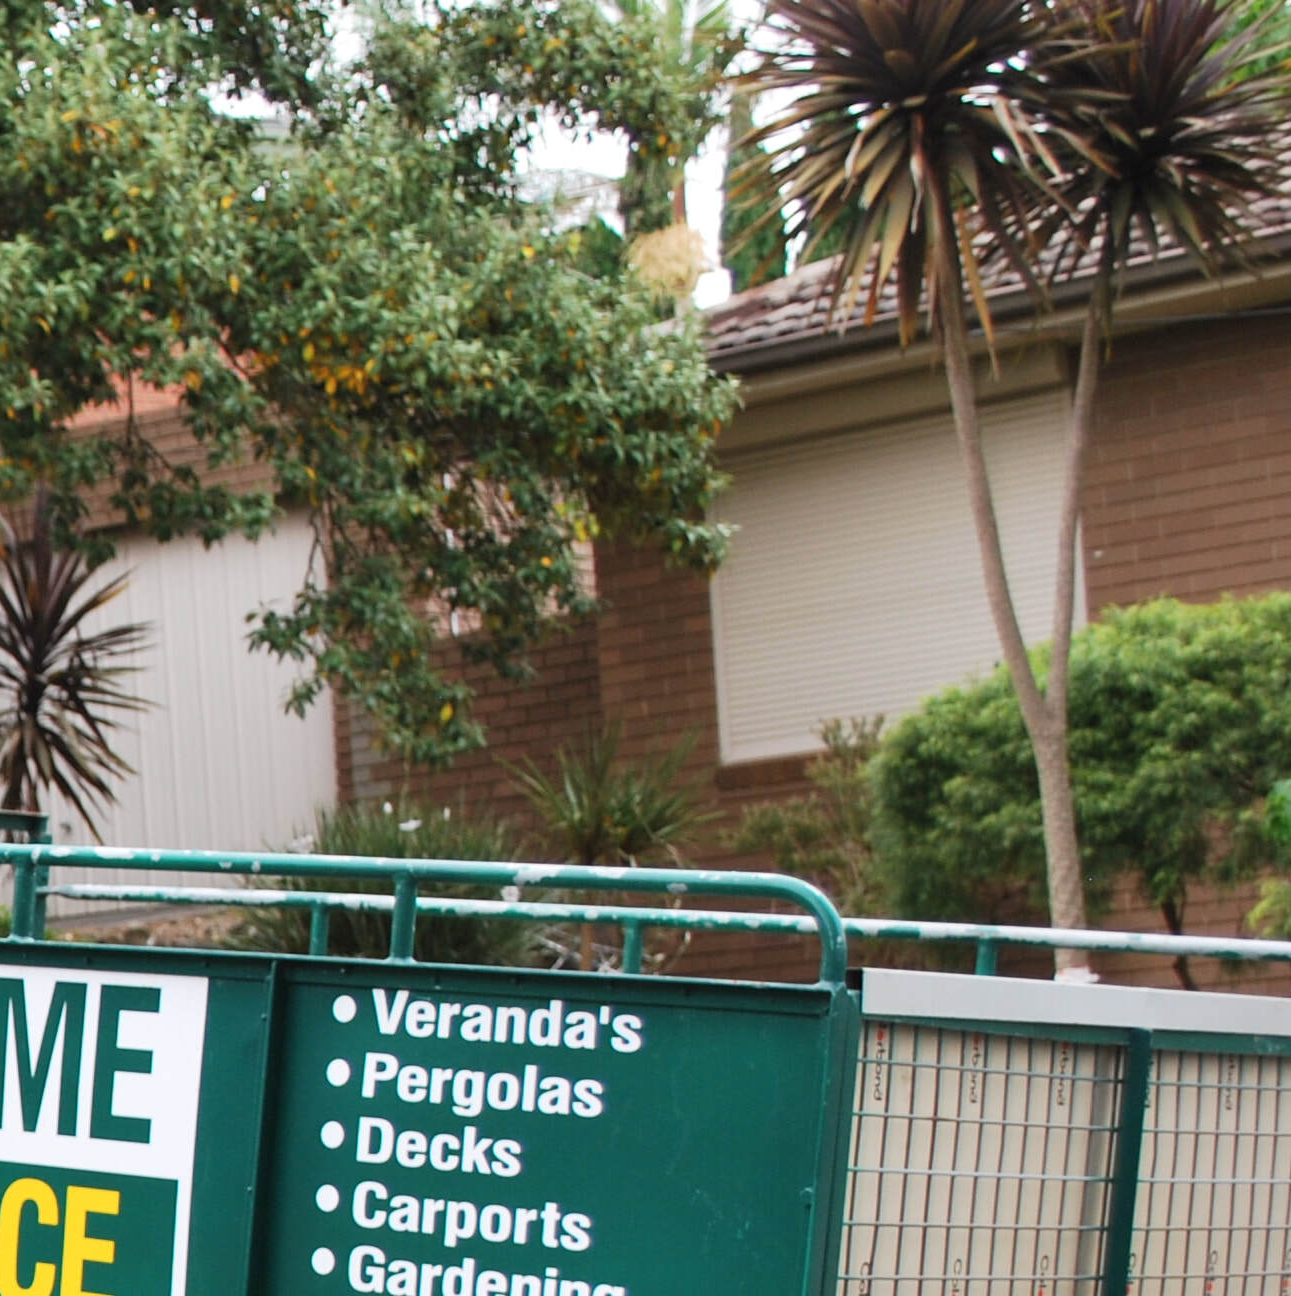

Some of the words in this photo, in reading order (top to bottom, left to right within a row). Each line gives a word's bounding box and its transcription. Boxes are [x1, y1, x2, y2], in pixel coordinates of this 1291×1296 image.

[373, 989, 642, 1053] Veranda's
[362, 1052, 604, 1117] Pergolas
[356, 1116, 522, 1177] Decks
[353, 1181, 592, 1251] Carports
